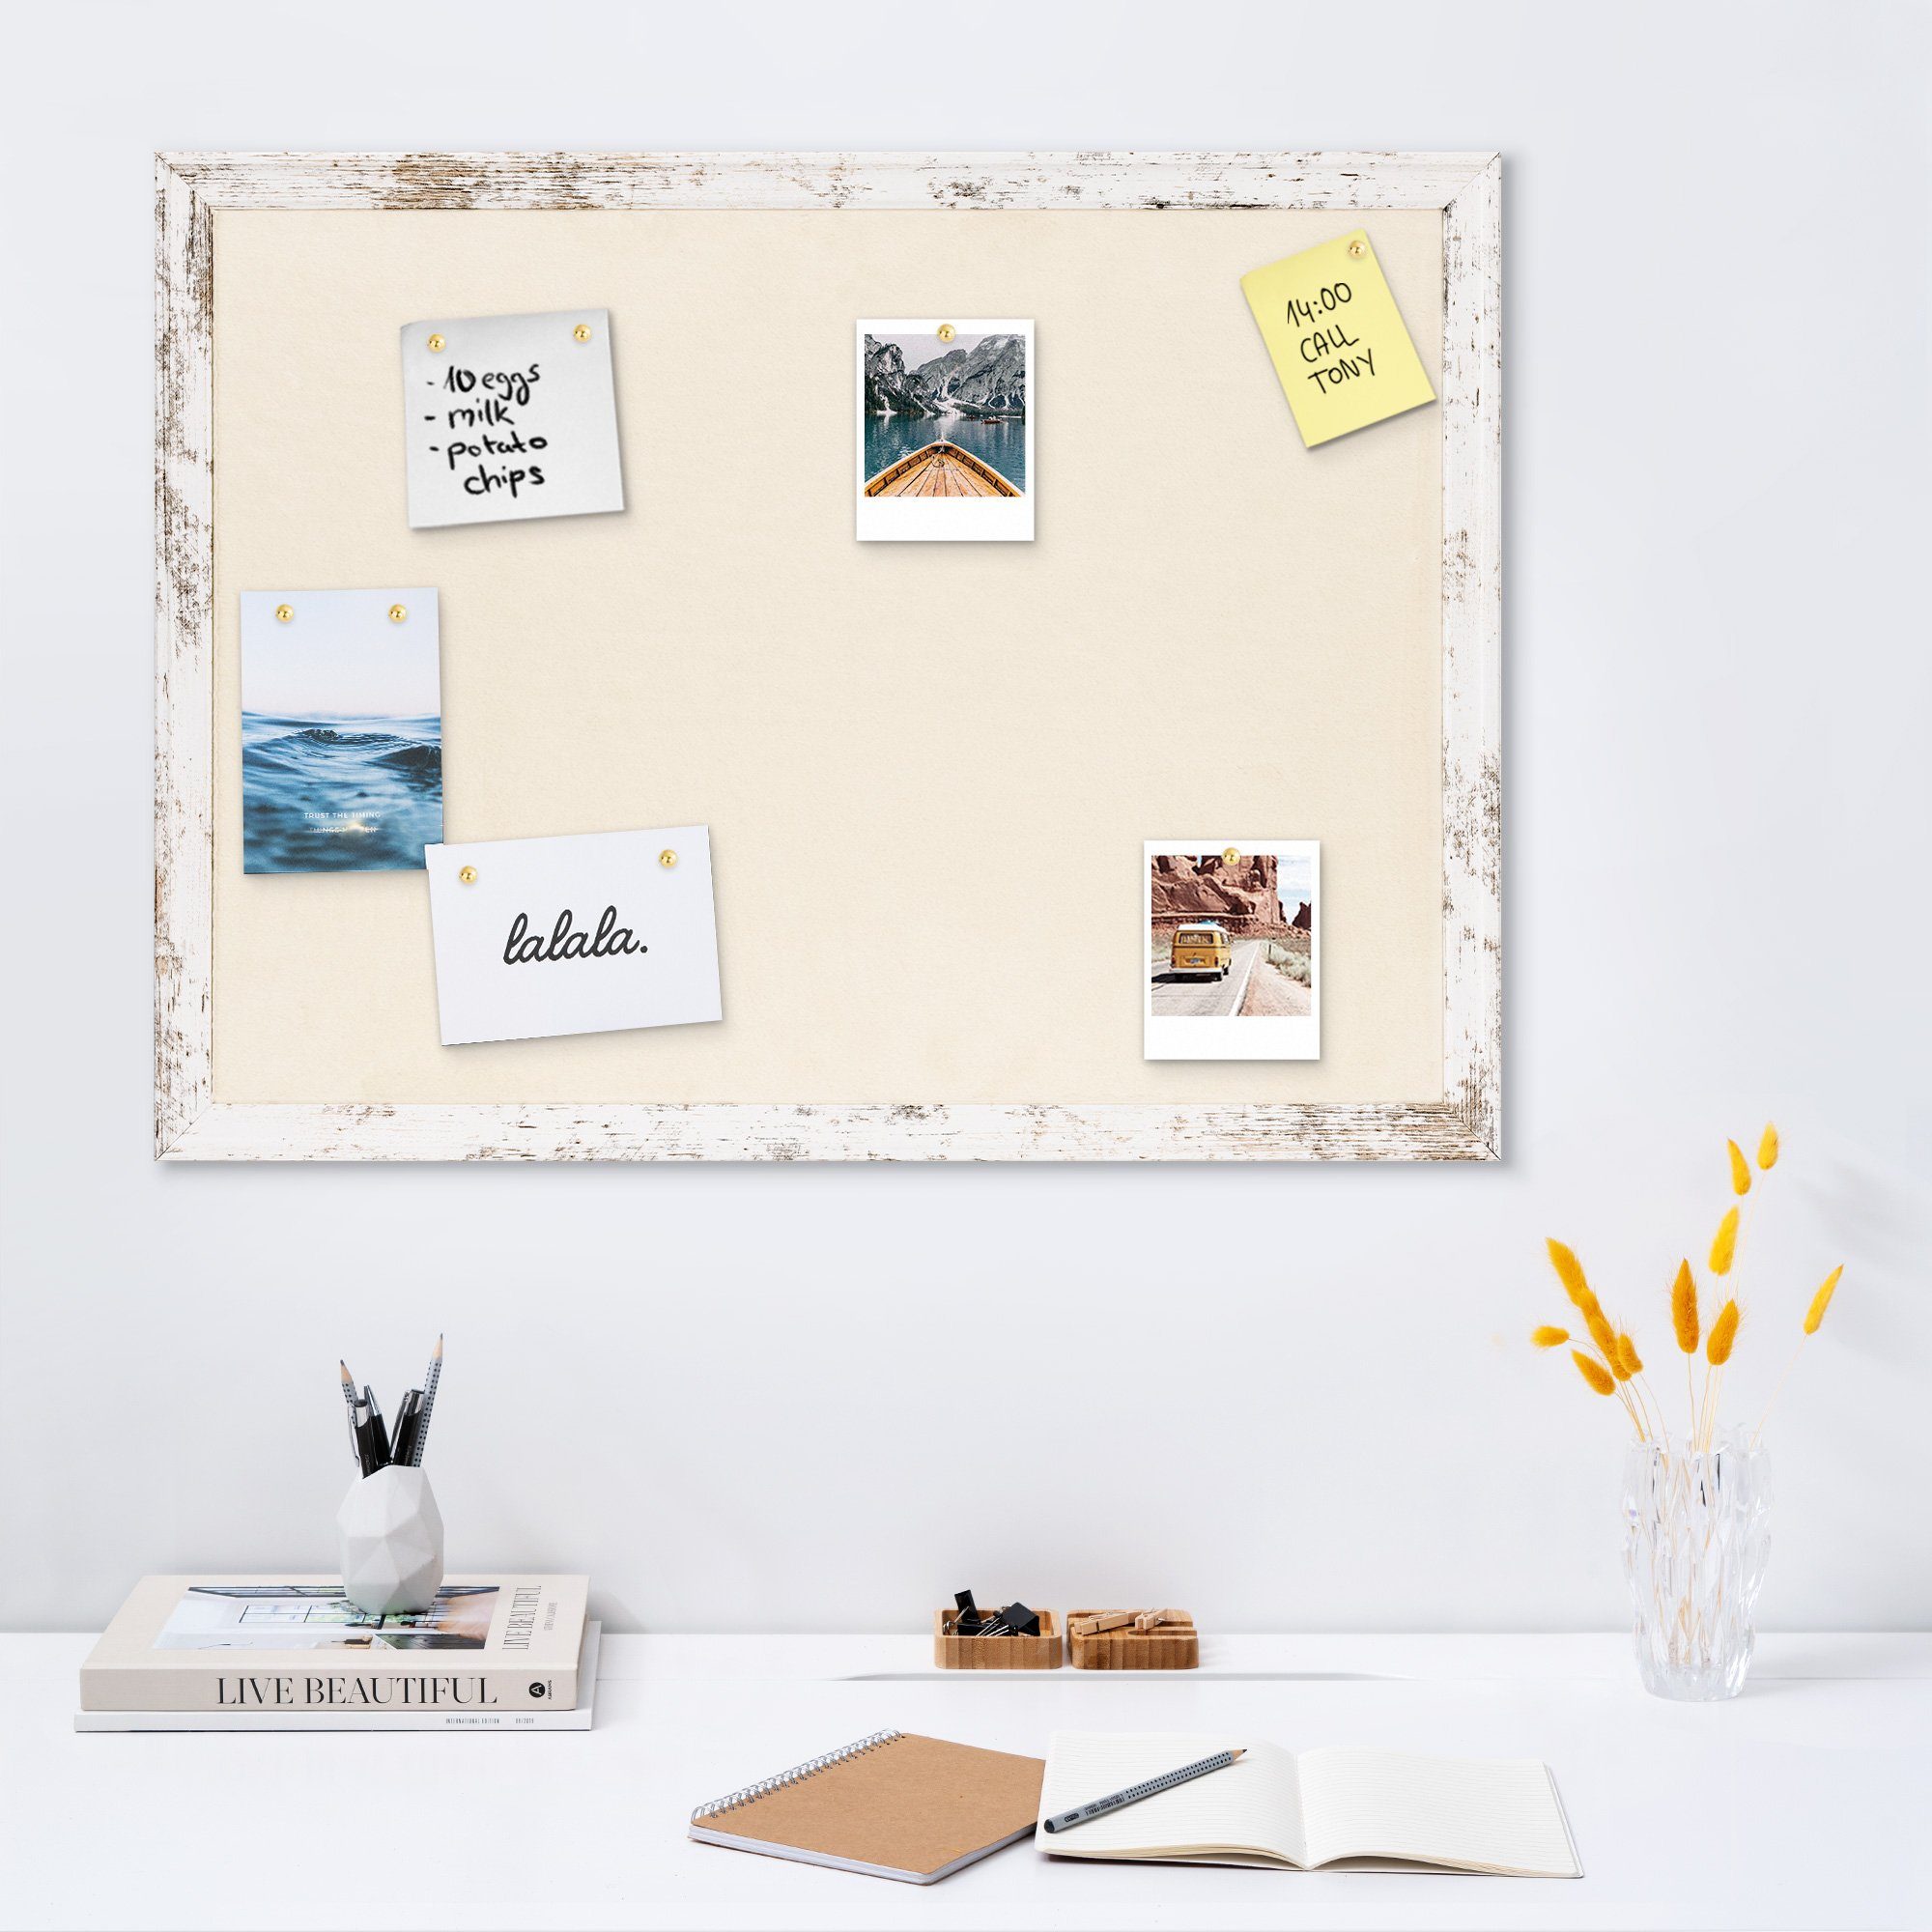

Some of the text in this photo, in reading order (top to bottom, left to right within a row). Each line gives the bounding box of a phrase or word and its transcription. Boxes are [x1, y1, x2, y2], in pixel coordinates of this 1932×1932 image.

[1287, 282, 1352, 327] 14:00
[1300, 324, 1360, 363] CALL
[442, 365, 477, 393] 10
[481, 363, 541, 407] eggs
[1307, 348, 1376, 394] TONY
[448, 398, 516, 429] milk
[447, 431, 549, 471] potato
[464, 465, 545, 498] chips
[503, 904, 649, 965] lalala.
[501, 1585, 542, 1650] LIVE BEAUTIFUL
[215, 1676, 498, 1705] LIVE BEAUTIFUL
